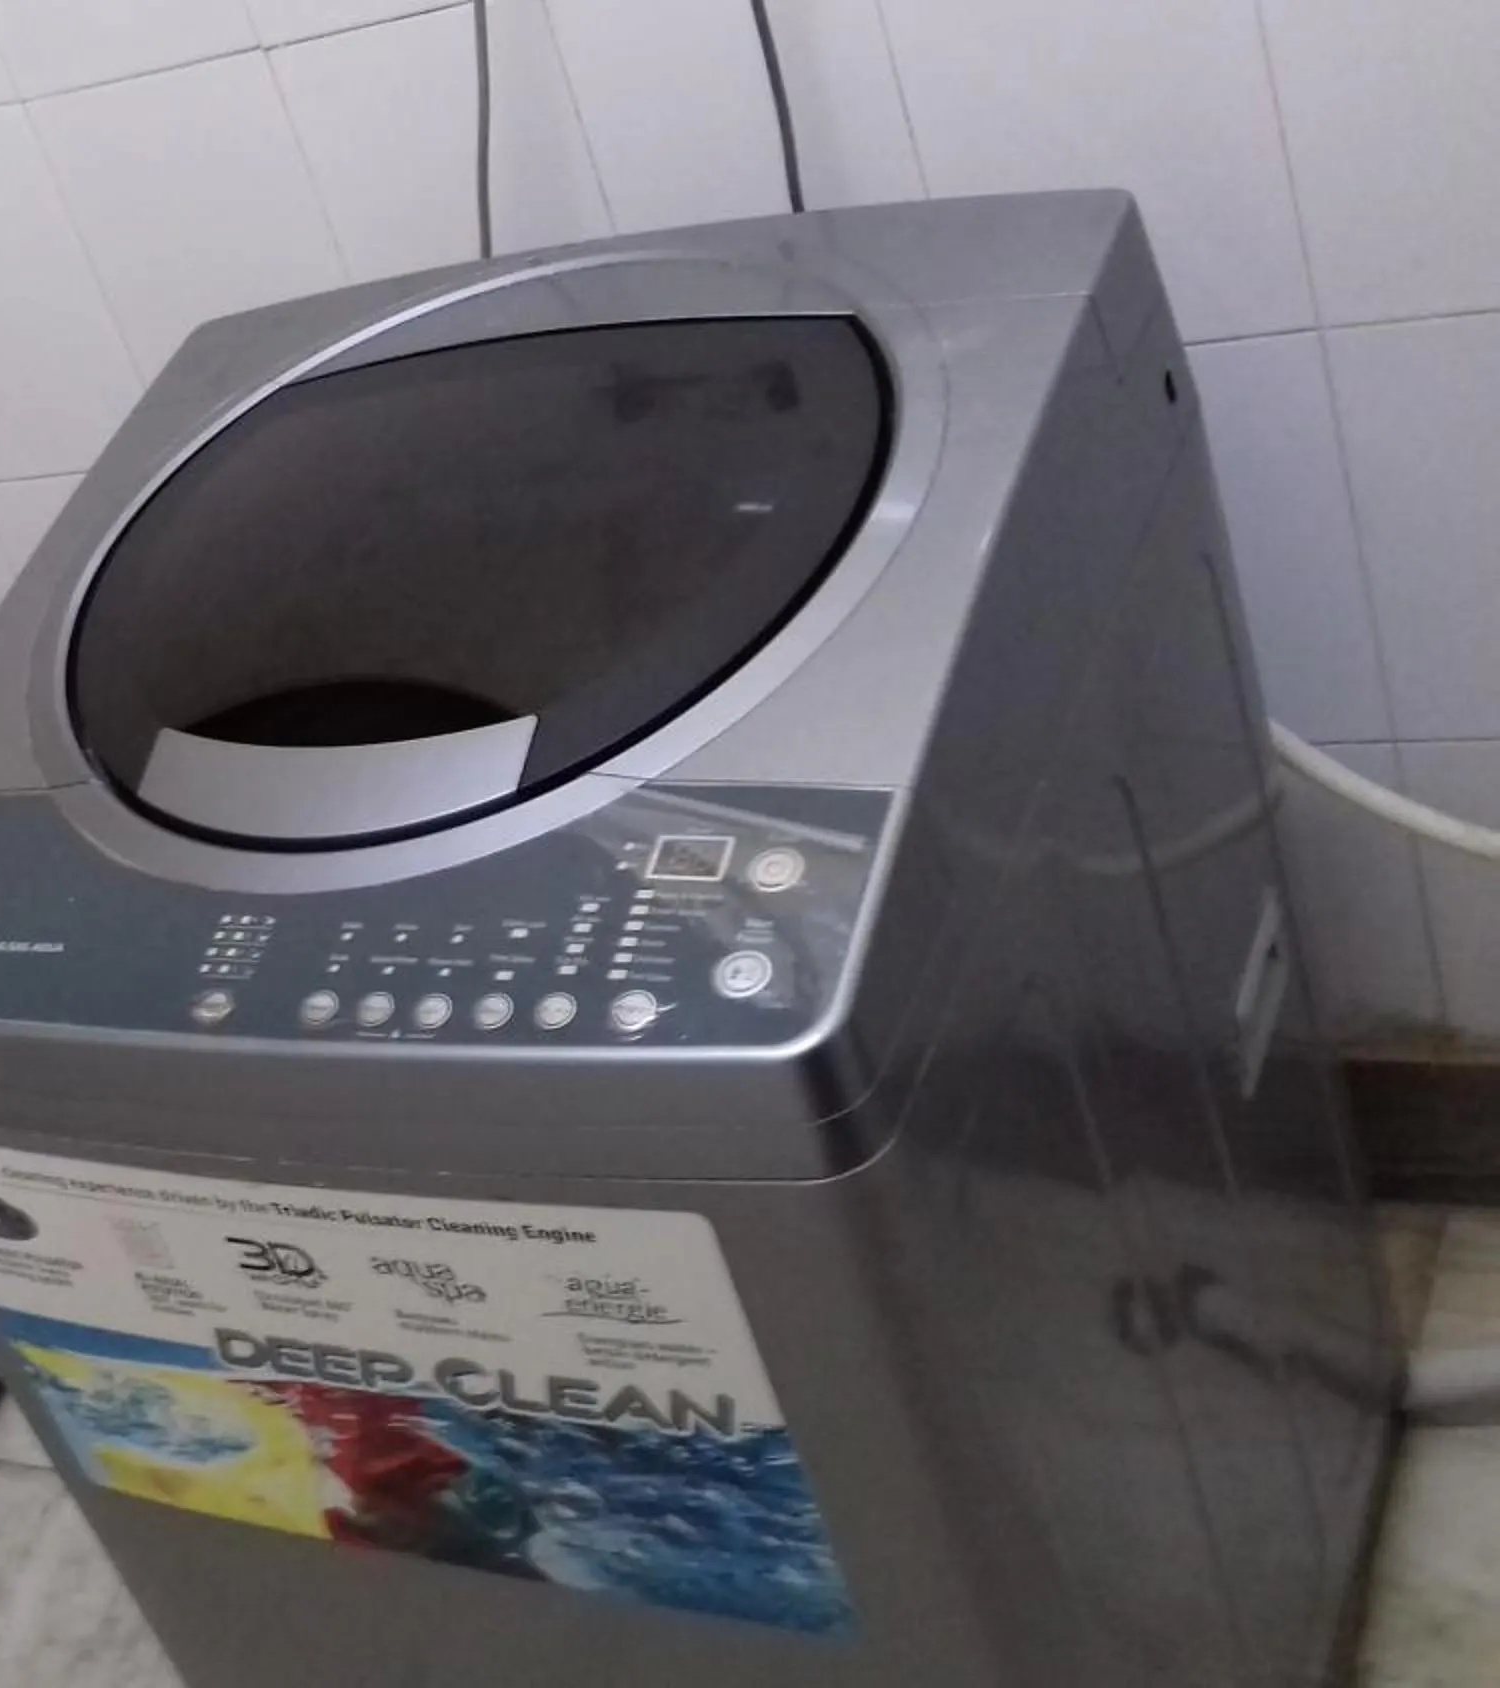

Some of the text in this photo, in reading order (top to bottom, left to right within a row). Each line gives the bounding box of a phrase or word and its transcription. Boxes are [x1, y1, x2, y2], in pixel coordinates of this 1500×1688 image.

[268, 1200, 337, 1222] Triadic
[340, 1208, 424, 1230] Pulsator
[426, 1216, 520, 1242] Cleaning
[521, 1224, 598, 1246] Engine
[225, 1236, 318, 1279] 3D
[370, 1255, 455, 1284] aqua
[420, 1281, 488, 1305] spa
[213, 1326, 737, 1437] DEEP CLEAN
